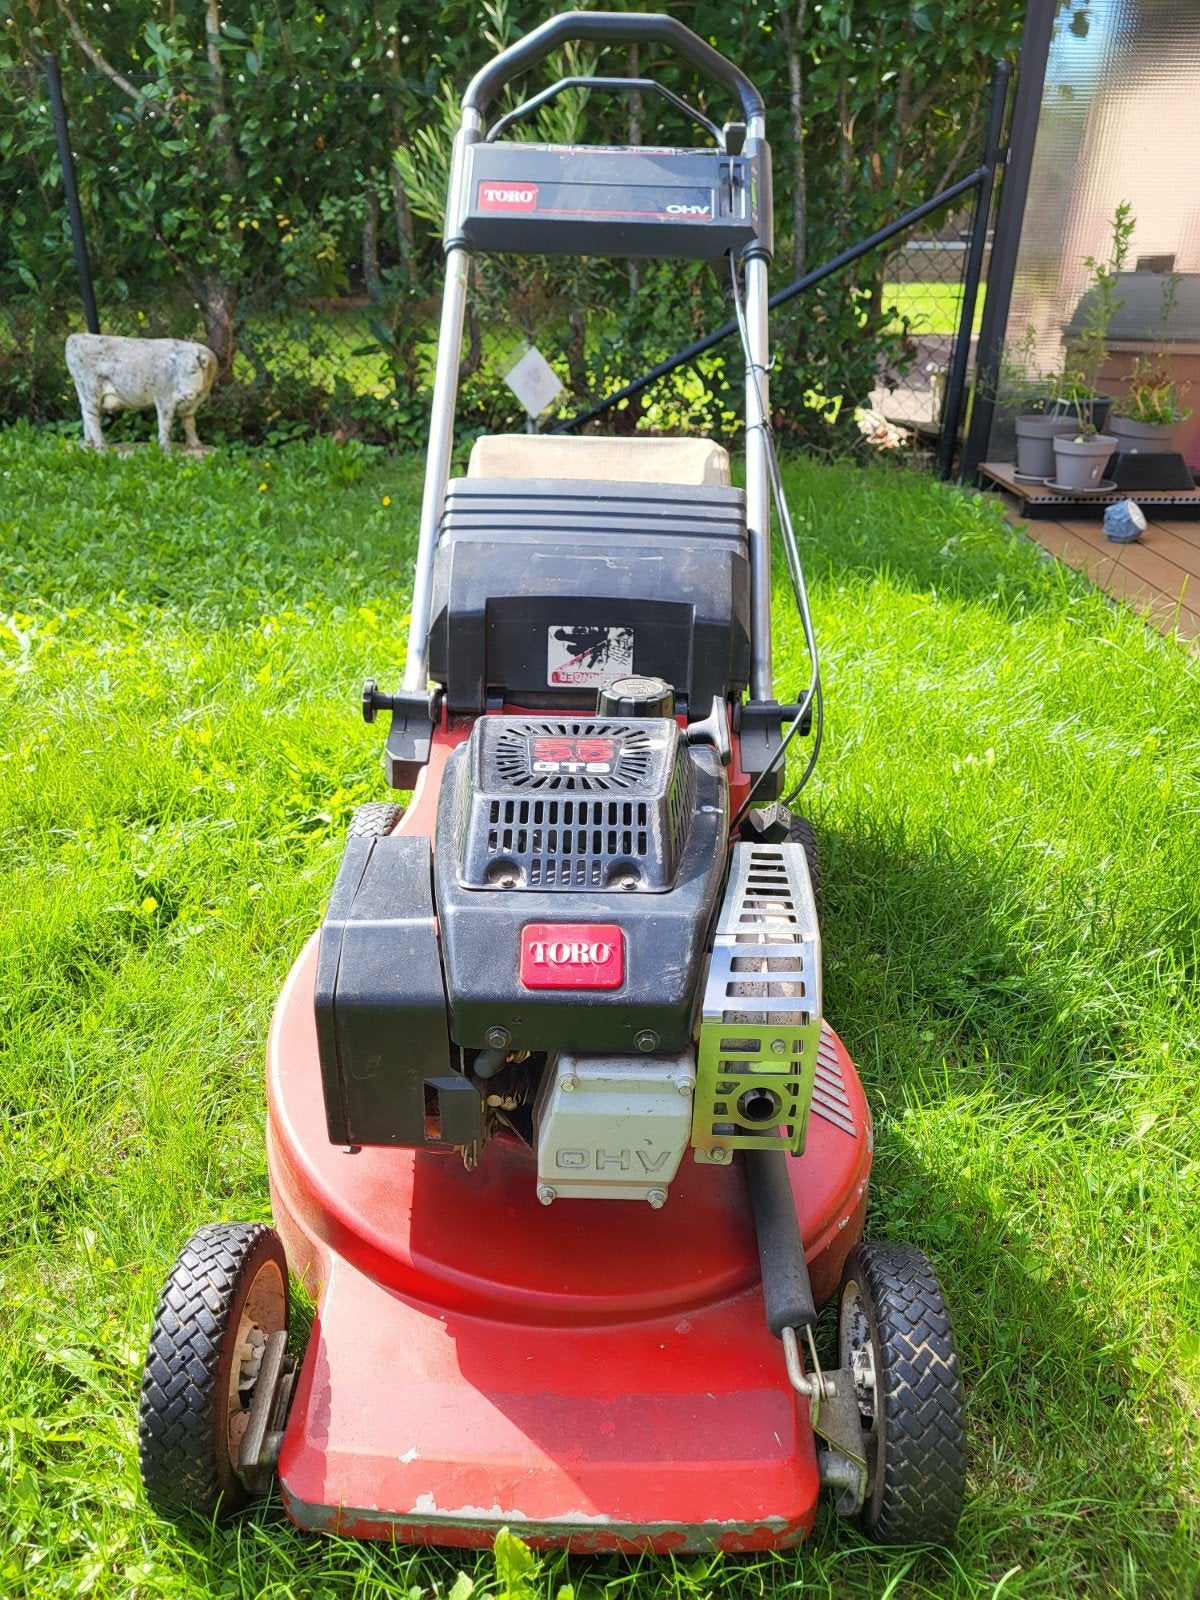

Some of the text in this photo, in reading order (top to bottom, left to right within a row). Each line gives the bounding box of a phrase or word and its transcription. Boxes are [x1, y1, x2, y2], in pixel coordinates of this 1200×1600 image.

[483, 189, 533, 203] TORO
[666, 205, 710, 215] OHV
[533, 738, 615, 762] 5.5
[533, 761, 611, 773] GTS
[529, 942, 610, 964] TORO
[556, 1149, 672, 1173] OHV
